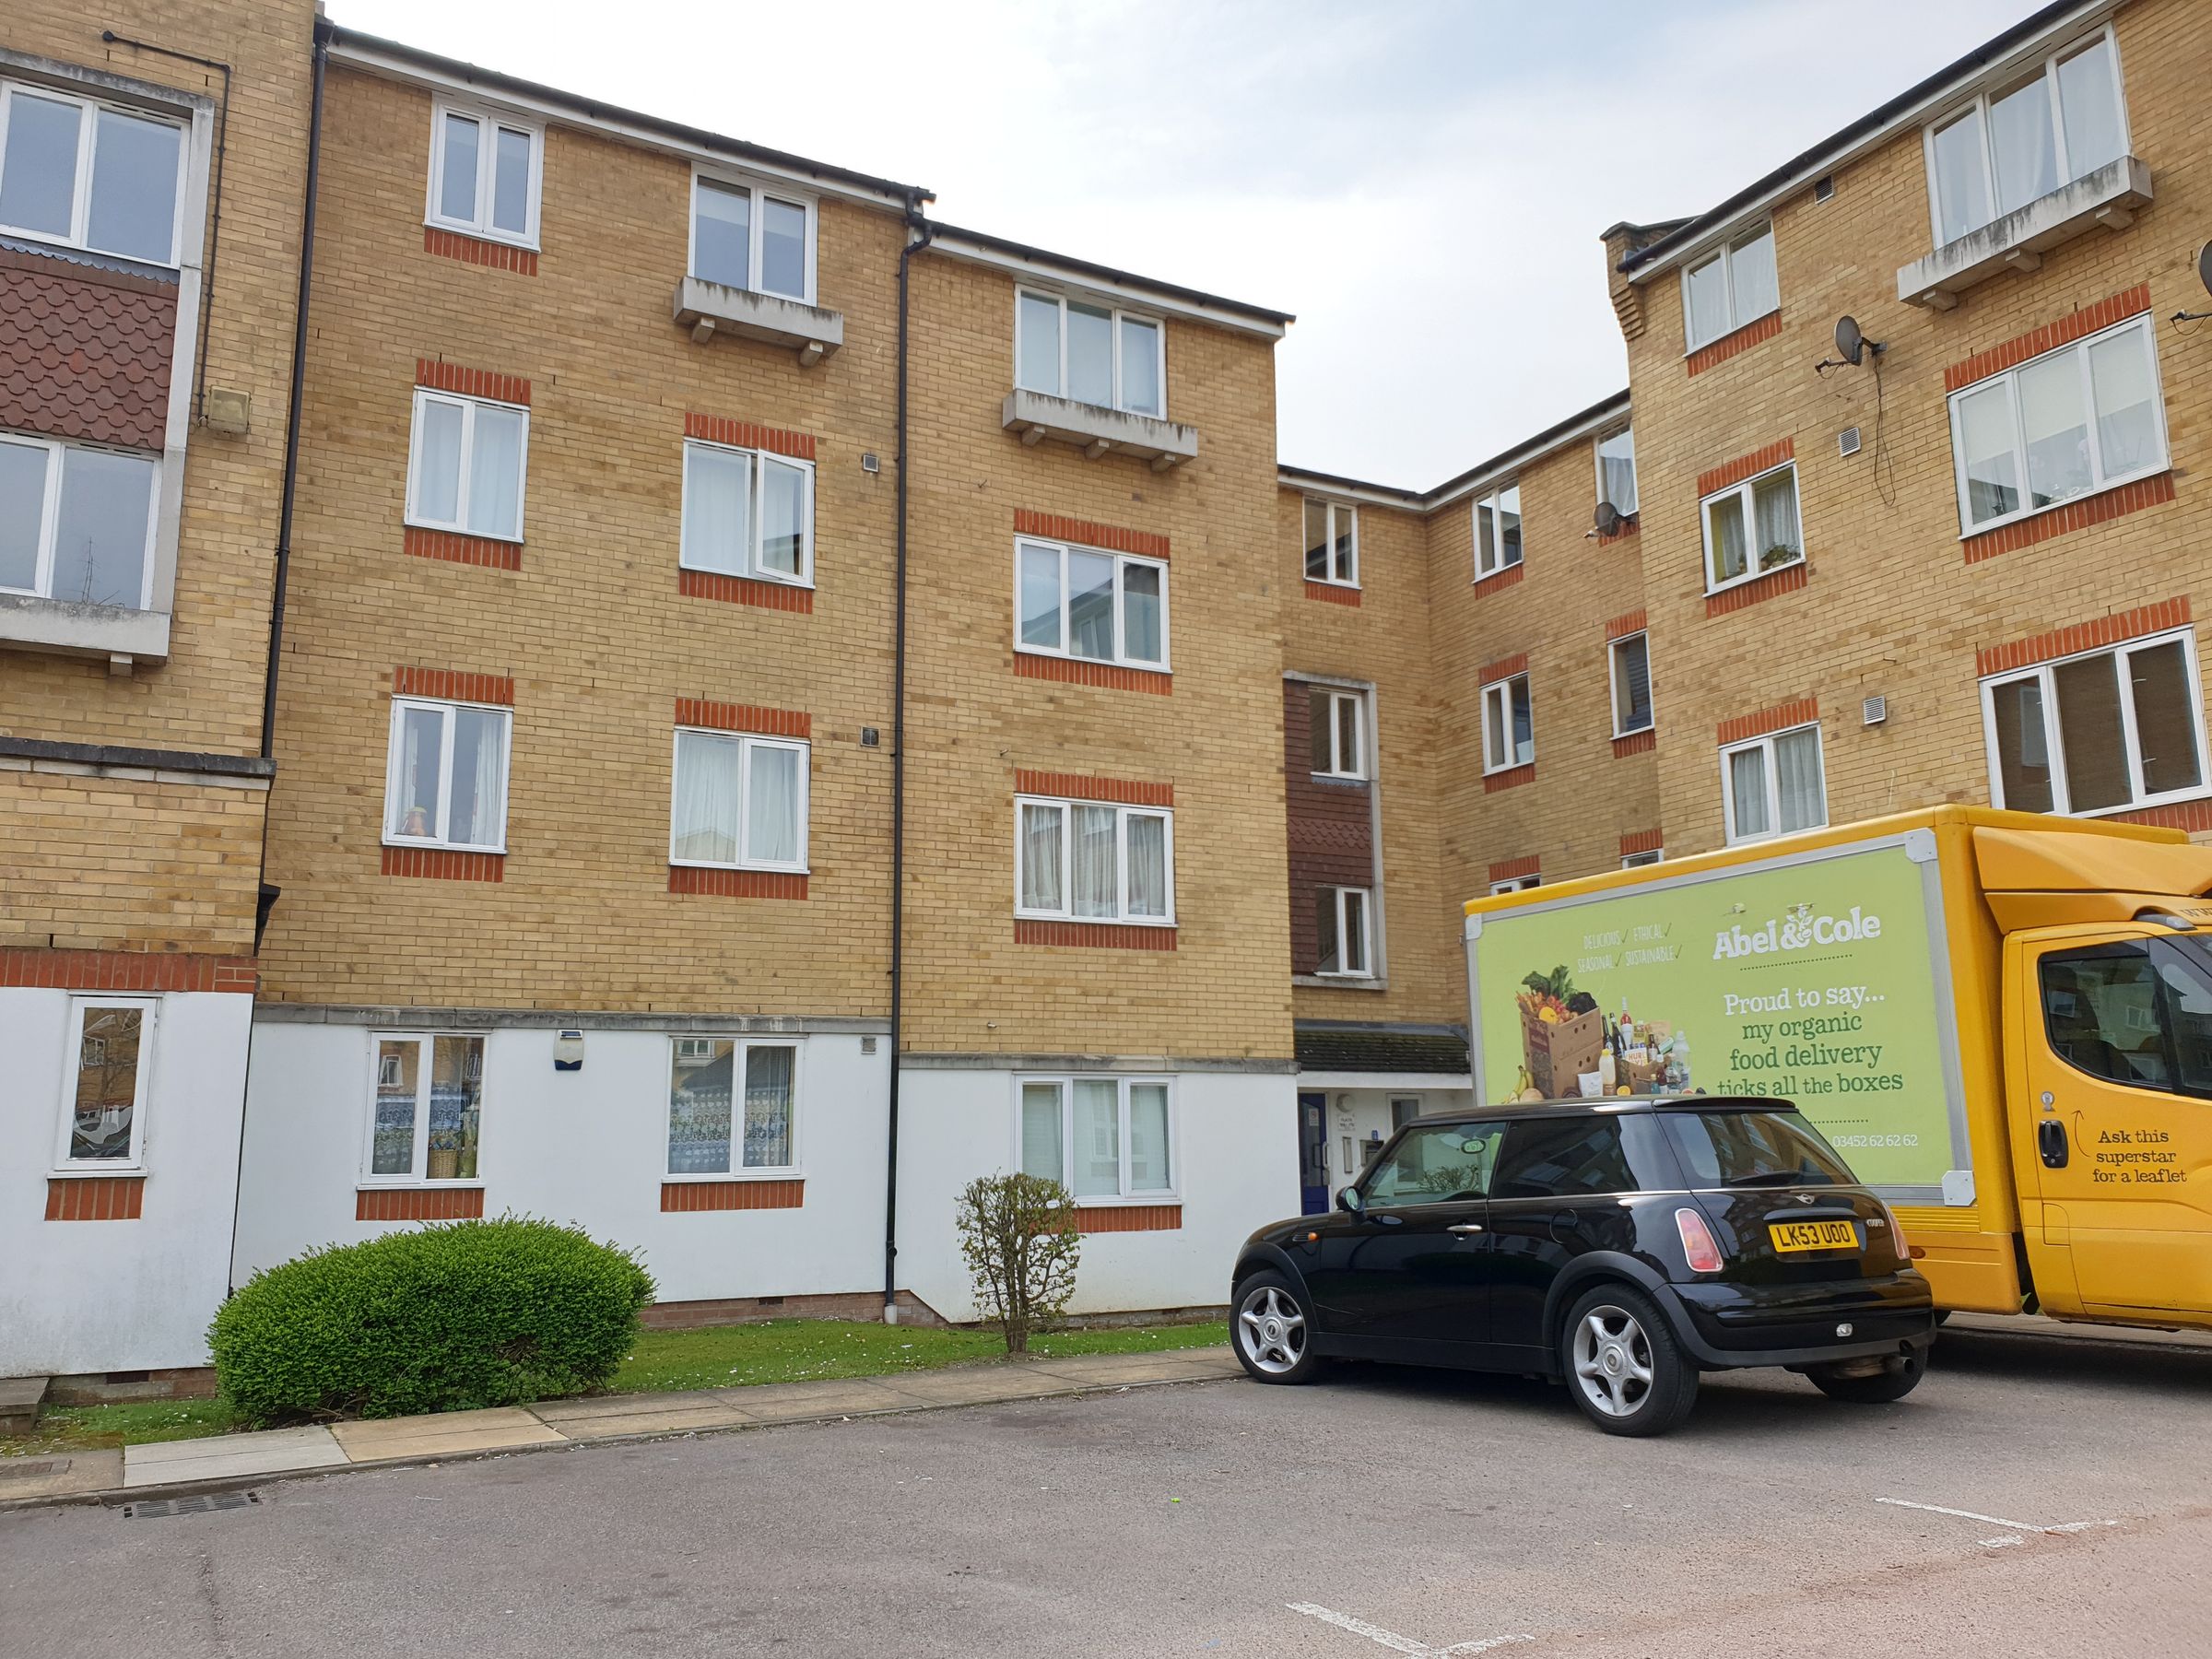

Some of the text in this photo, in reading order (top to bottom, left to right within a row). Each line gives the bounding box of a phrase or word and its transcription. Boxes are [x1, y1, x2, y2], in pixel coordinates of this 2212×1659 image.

[1583, 924, 1664, 949] DELICIOUS ETHICAL
[1712, 919, 1779, 959] Abel
[1813, 906, 1881, 945] Cole
[1578, 946, 1674, 972] SEASONAL SUSTAINABLE
[1724, 988, 1792, 1016] Proud
[1795, 988, 1820, 1007] to
[1742, 1011, 1862, 1044] my organic
[1730, 1043, 1882, 1071] food delivery
[1718, 1073, 1903, 1096] ticks all the boxes
[1832, 1135, 1918, 1147] 03452 62 62 62
[2098, 1129, 2169, 1143] Ask this
[2096, 1150, 2176, 1166] superstar
[2093, 1168, 2187, 1182] for a leaflet
[1777, 1225, 1819, 1247] LK53
